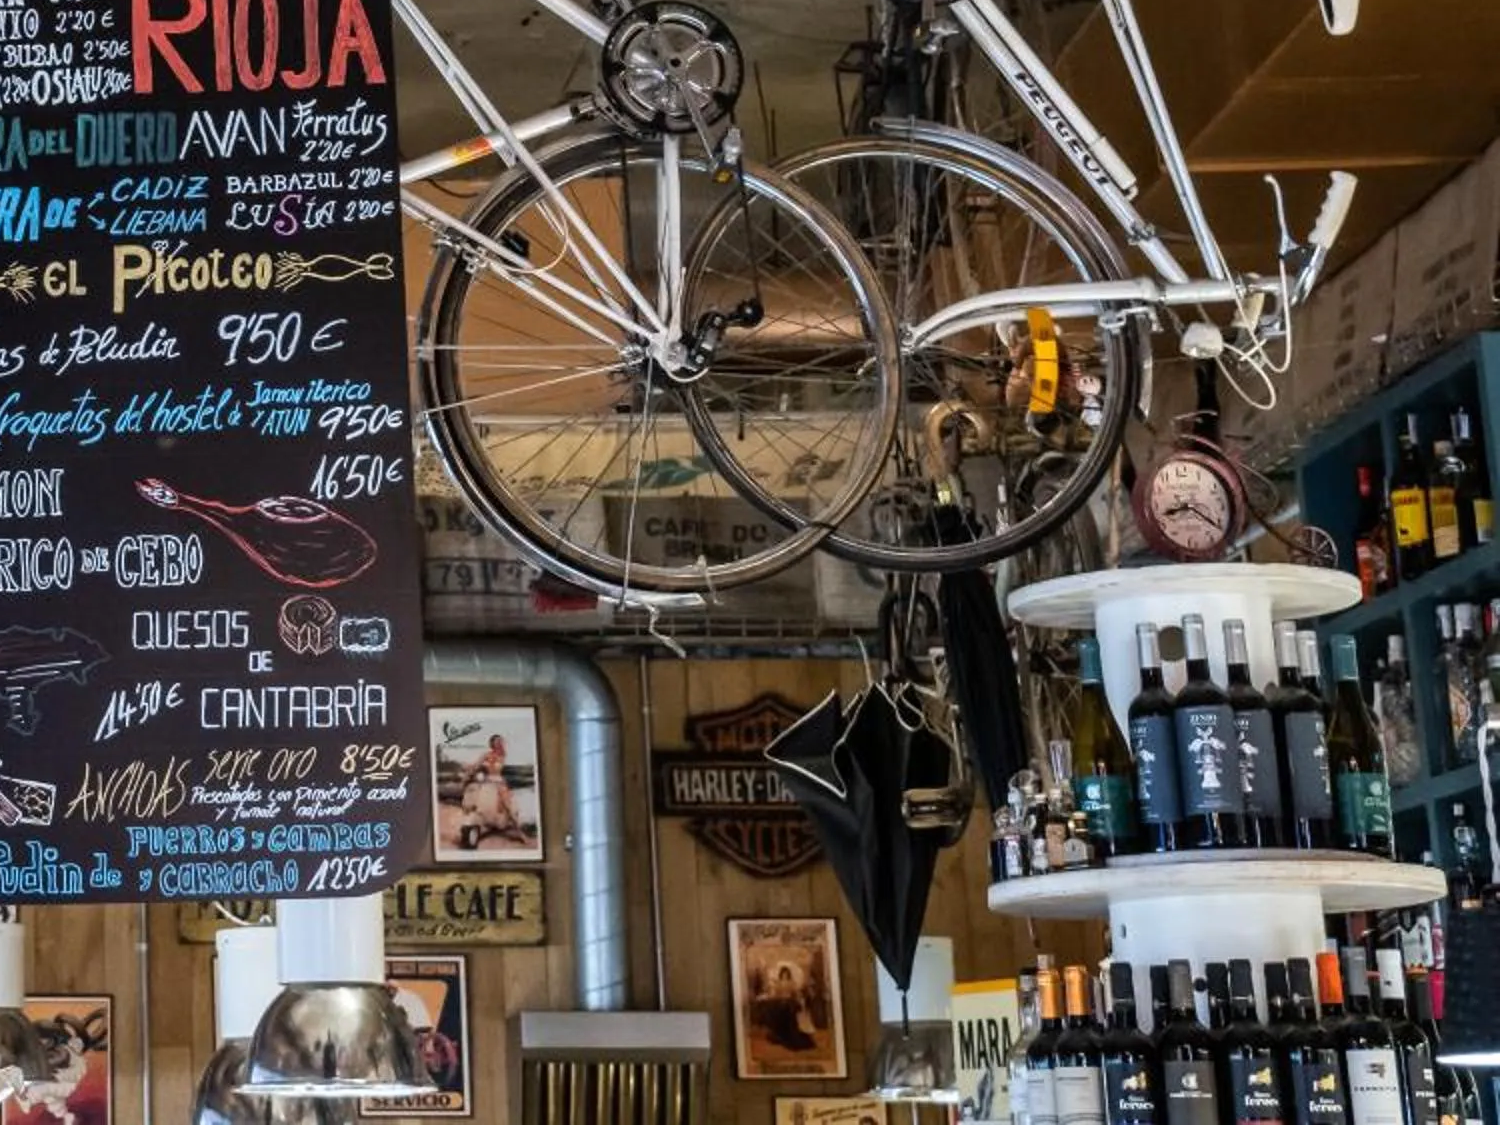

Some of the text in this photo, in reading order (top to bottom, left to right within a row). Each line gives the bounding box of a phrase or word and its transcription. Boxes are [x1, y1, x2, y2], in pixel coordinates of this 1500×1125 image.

[27, 129, 74, 157] DEL
[75, 110, 178, 168] DUERO
[179, 105, 288, 161] AVAN
[290, 96, 389, 157] Ferratus
[1014, 71, 1110, 187] PEUGEOT
[226, 171, 344, 196] BARBAZUL
[43, 196, 83, 229] DE
[43, 258, 88, 298] EL
[113, 391, 159, 435] del
[260, 406, 312, 436] ATUN
[79, 545, 110, 573] DE
[115, 531, 204, 589] CEBO
[131, 608, 250, 652] QUESOS
[248, 649, 275, 673] DE
[673, 768, 797, 804] HARLEY-DA
[89, 851, 123, 889] de
[444, 882, 524, 922] CAFE
[957, 1015, 1013, 1071] MARA
